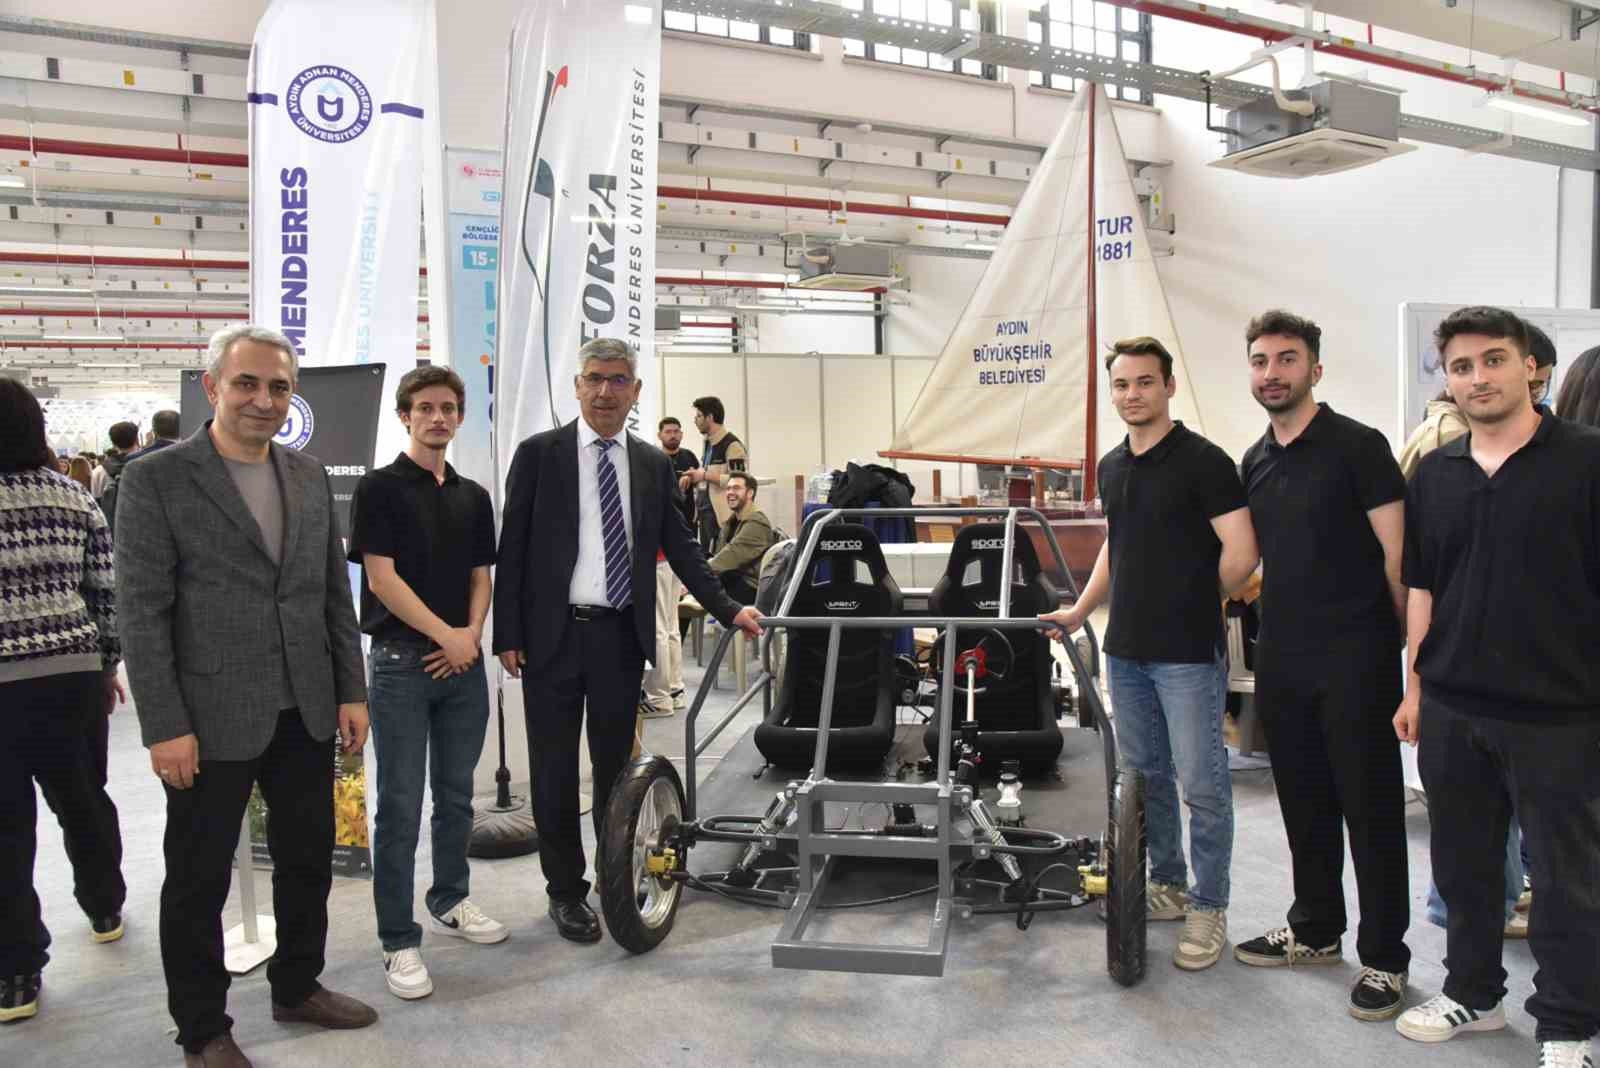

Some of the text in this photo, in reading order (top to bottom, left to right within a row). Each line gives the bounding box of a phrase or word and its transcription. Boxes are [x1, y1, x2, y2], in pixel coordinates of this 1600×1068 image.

[288, 67, 371, 121] AYDIN ADNAN MENDERES
[462, 232, 498, 240] BÖLGESE
[1097, 215, 1133, 238] TUR
[280, 166, 308, 356] MENDERES
[1097, 240, 1132, 262] 1881
[627, 245, 642, 352] ENDERES
[996, 320, 1029, 336] AYDIN
[973, 340, 1053, 365] BÜYÜKŞEHİR
[979, 365, 1046, 385] BELEDİYESİ
[324, 465, 366, 475] DERES
